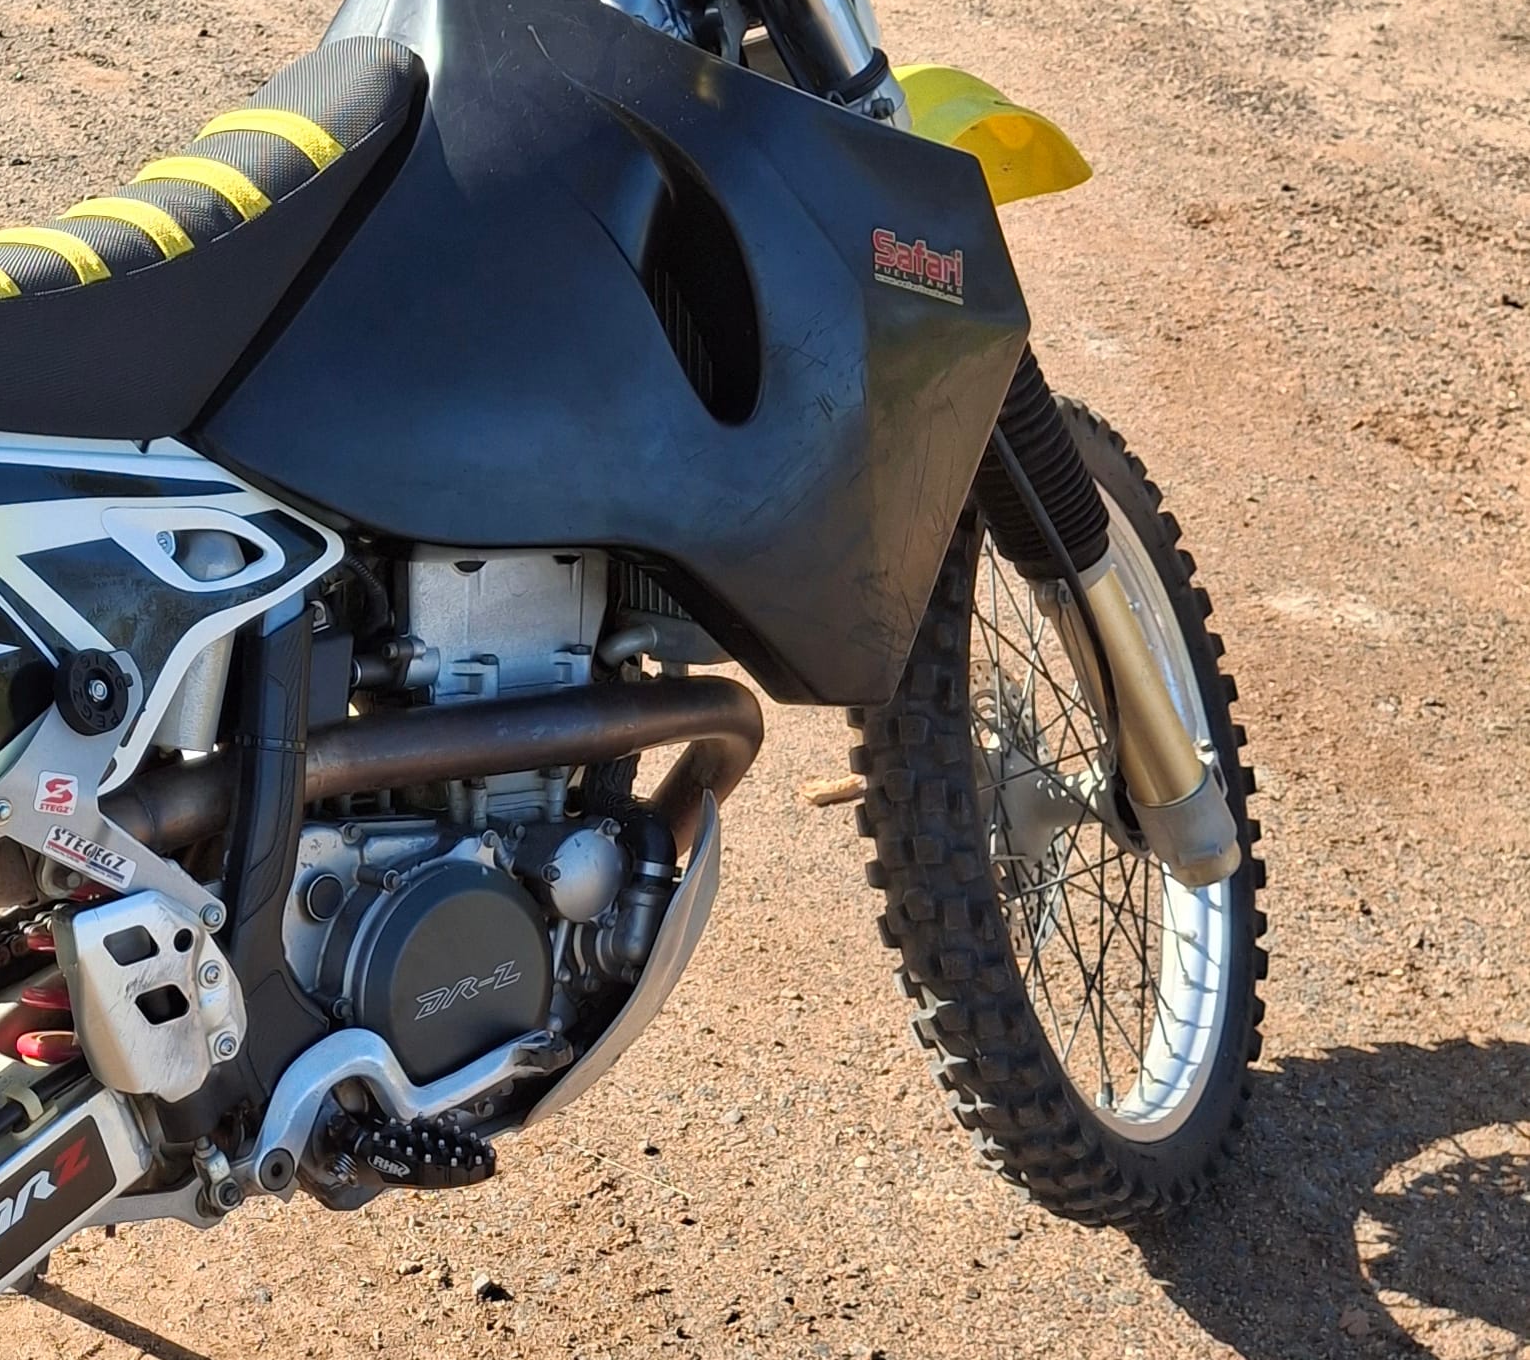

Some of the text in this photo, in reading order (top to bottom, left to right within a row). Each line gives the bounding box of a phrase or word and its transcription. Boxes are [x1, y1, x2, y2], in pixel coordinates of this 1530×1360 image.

[873, 228, 963, 287] Safari
[874, 263, 909, 280] FUEL
[39, 802, 70, 814] STEGZ
[414, 959, 522, 1021] DR-Z
